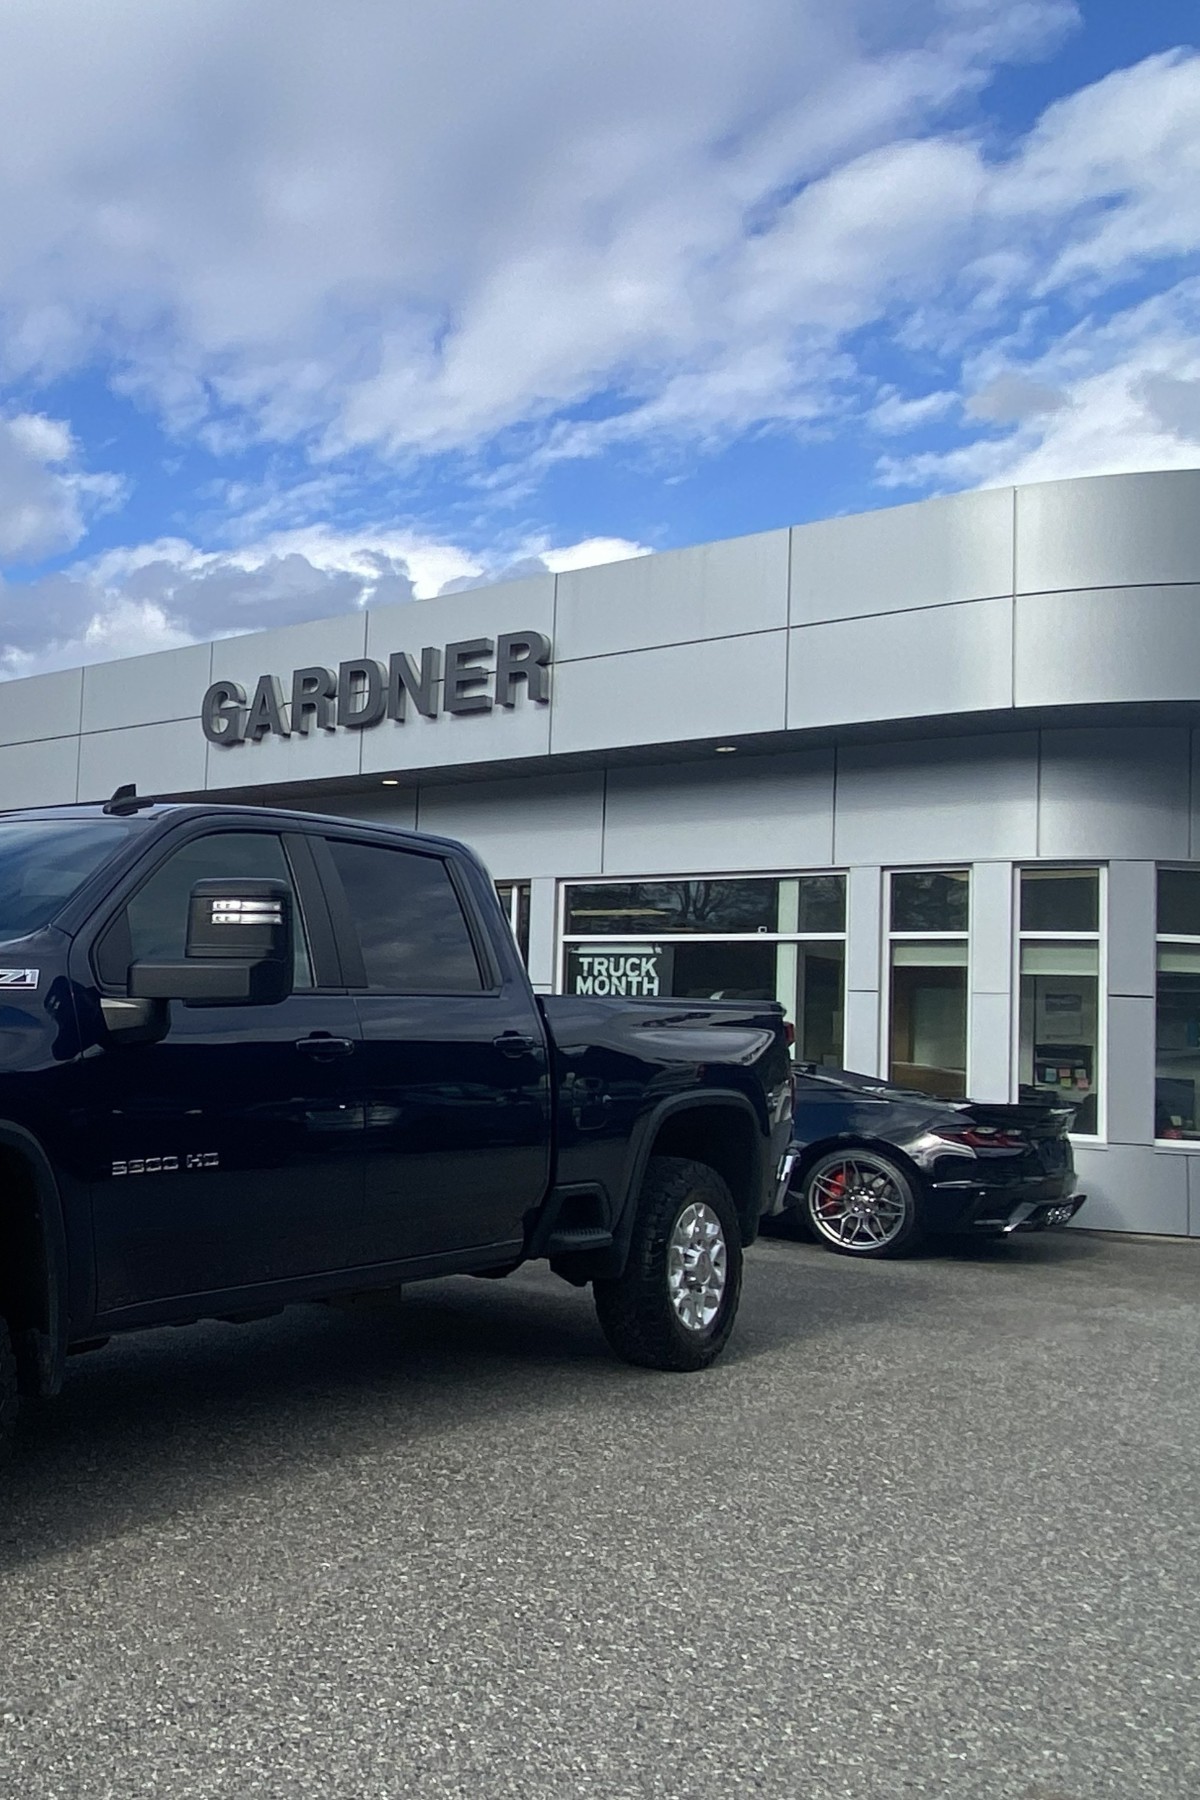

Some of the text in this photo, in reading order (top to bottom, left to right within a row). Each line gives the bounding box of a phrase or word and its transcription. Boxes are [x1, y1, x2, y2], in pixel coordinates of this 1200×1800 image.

[201, 631, 552, 746] GARDNER
[579, 957, 657, 977] TRUCK
[576, 975, 659, 996] MONTH
